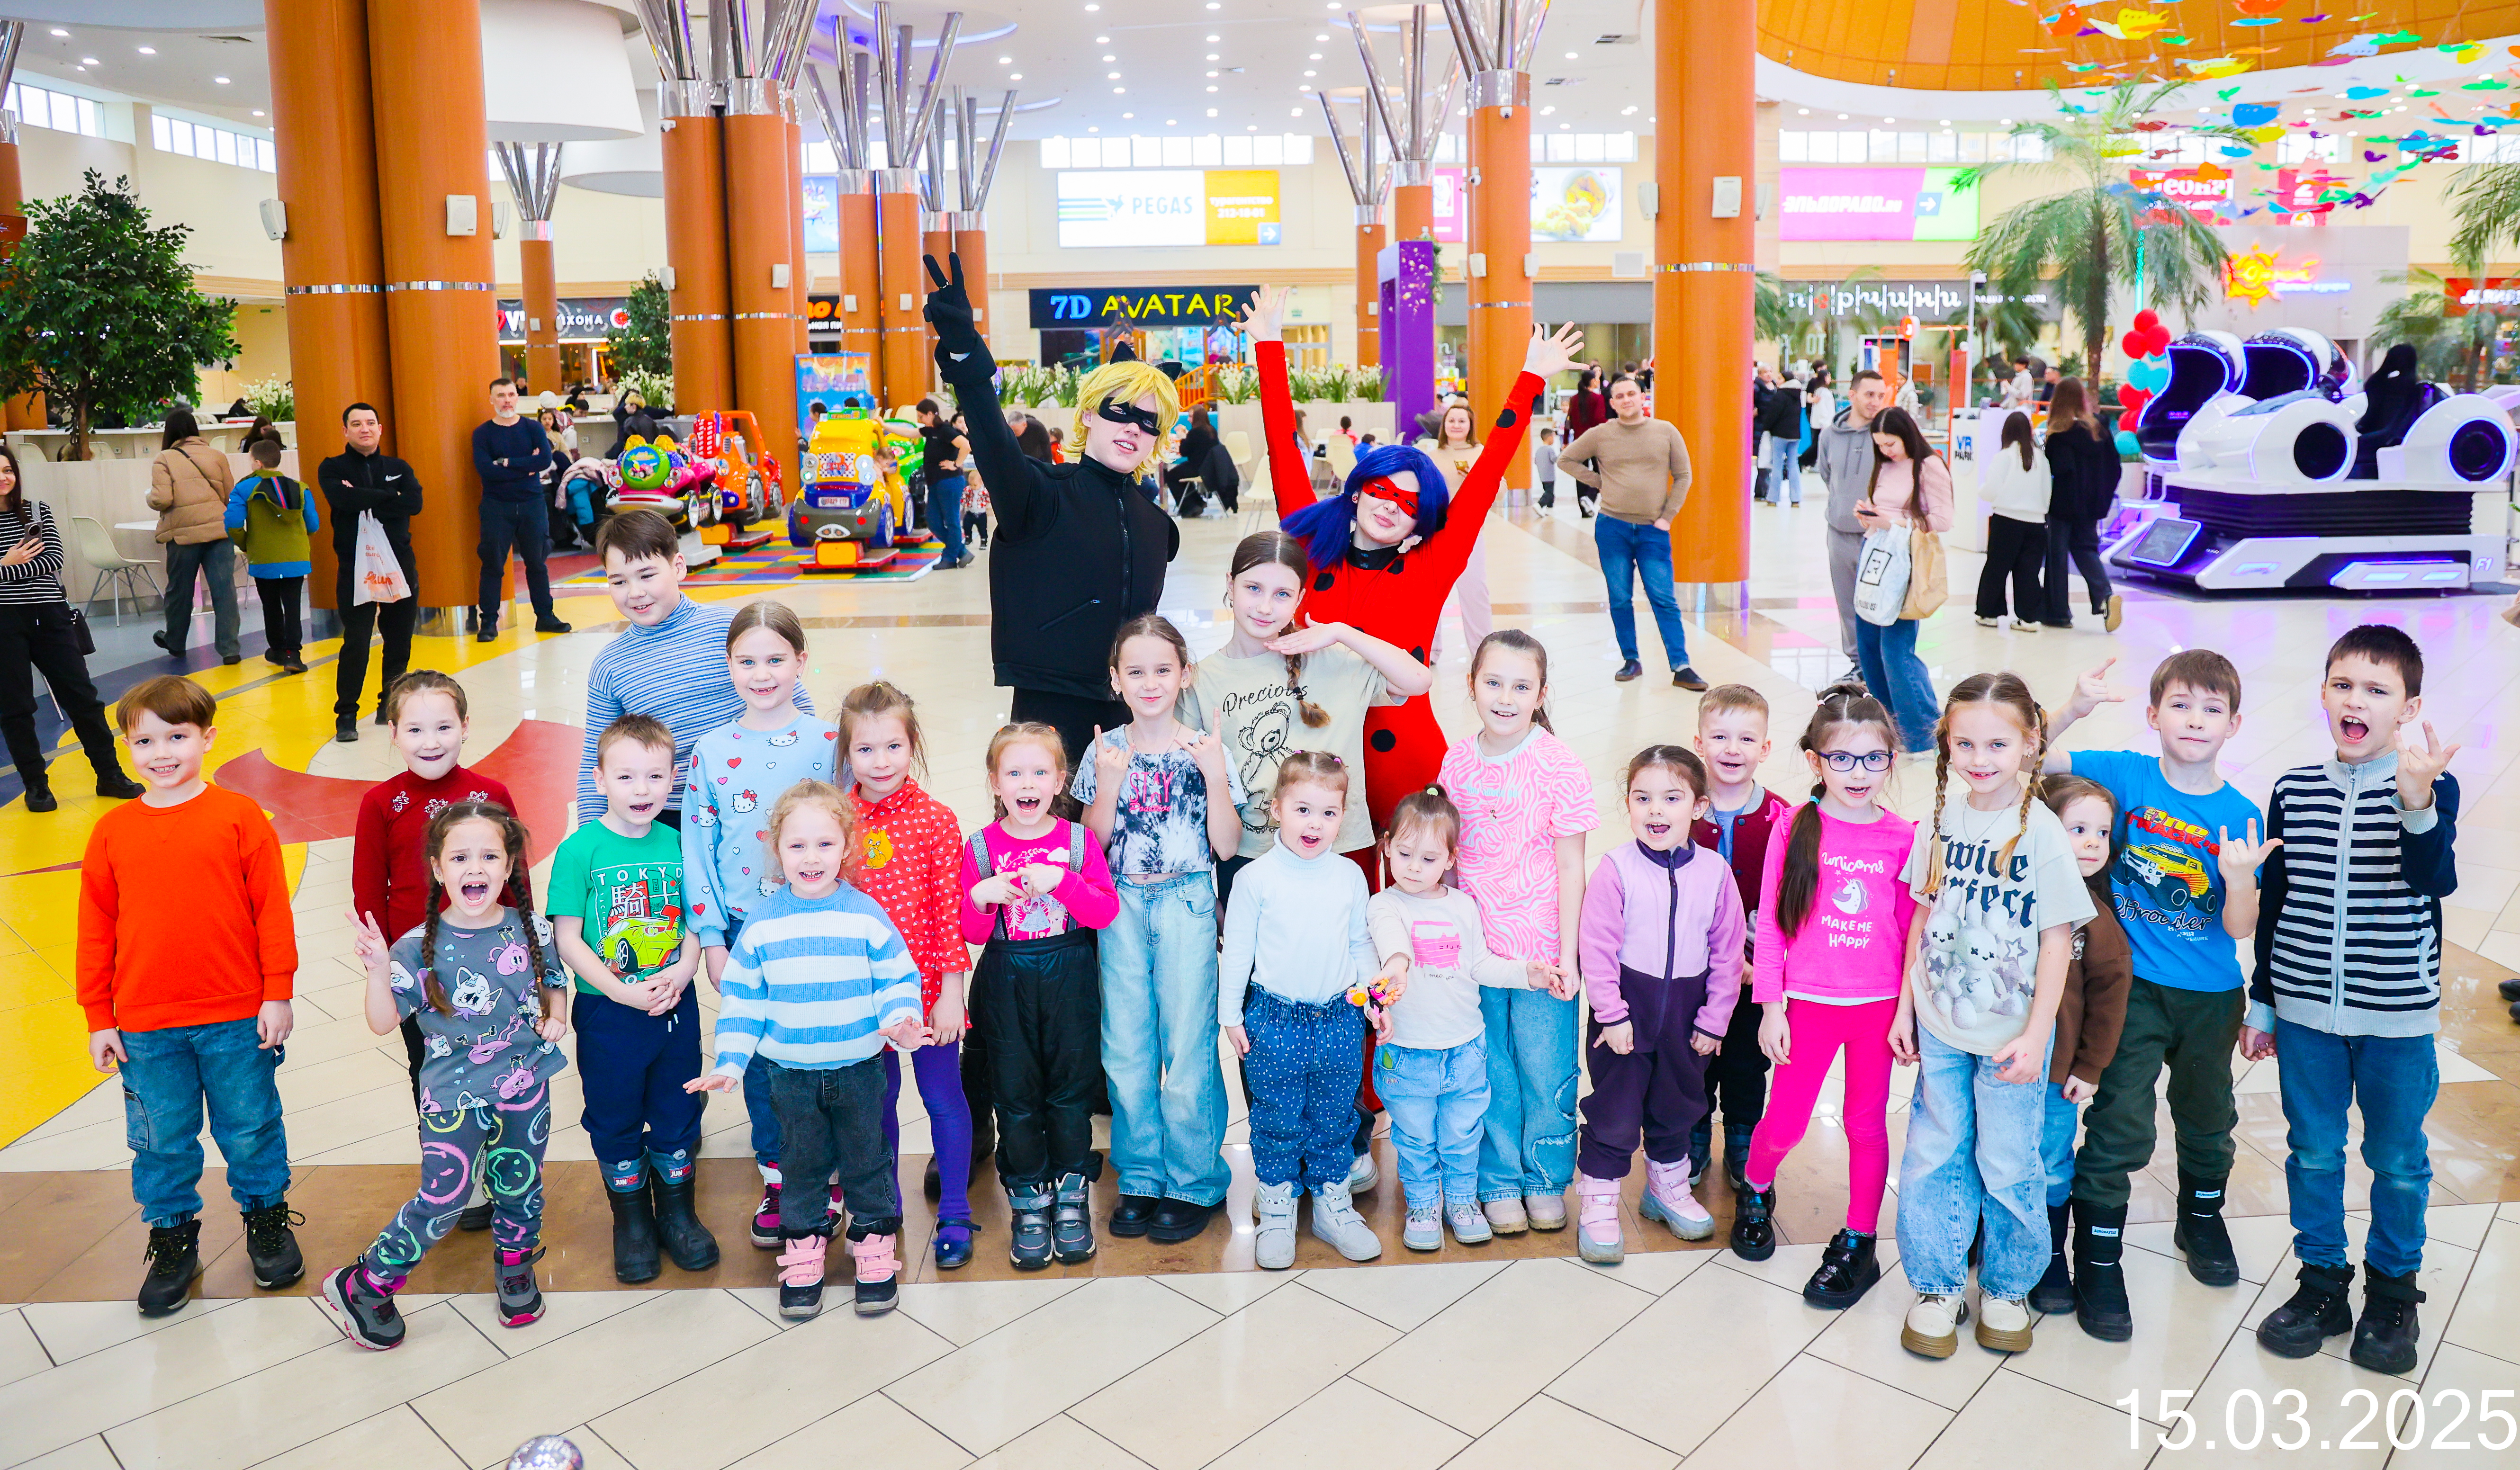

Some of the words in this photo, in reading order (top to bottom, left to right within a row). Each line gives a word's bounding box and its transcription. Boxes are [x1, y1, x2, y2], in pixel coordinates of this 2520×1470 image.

[1133, 197, 1193, 214] PEGAS
[1050, 295, 1092, 320] 7D
[1101, 294, 1236, 318] AVATAR
[1957, 436, 1972, 450] VR
[2474, 557, 2493, 572] F1
[1130, 771, 1174, 804] STAY
[1821, 914, 1856, 932] MAKE
[1857, 922, 1872, 932] ME
[1829, 933, 1870, 949] HAPPY
